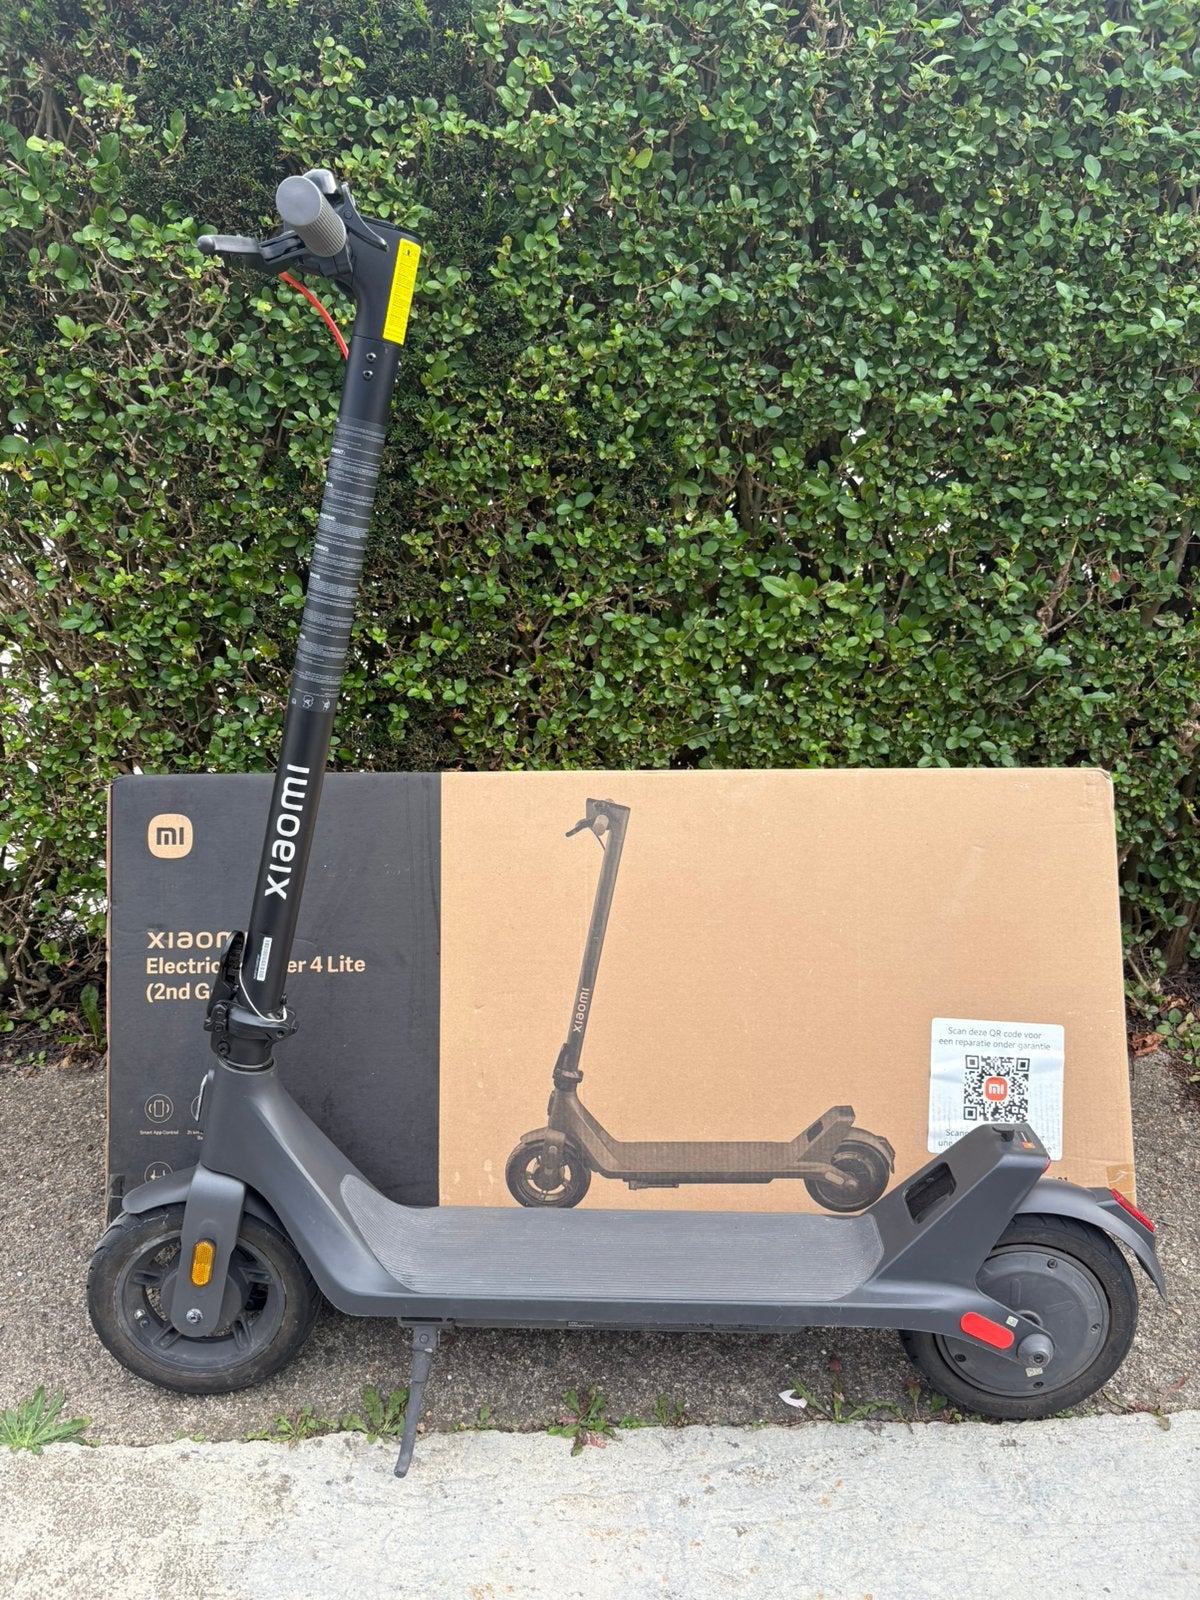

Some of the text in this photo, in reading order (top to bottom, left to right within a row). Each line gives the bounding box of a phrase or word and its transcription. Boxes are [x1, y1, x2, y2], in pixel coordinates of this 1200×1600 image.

[264, 763, 310, 900] xiaomi
[310, 955, 323, 973] 4
[327, 954, 366, 973] Lite
[146, 982, 191, 1003] (2nd
[573, 987, 590, 1033] xiaomi
[948, 1026, 1043, 1040] Scan deze QR code voor
[938, 1038, 1051, 1051] een reparatie onder garantie
